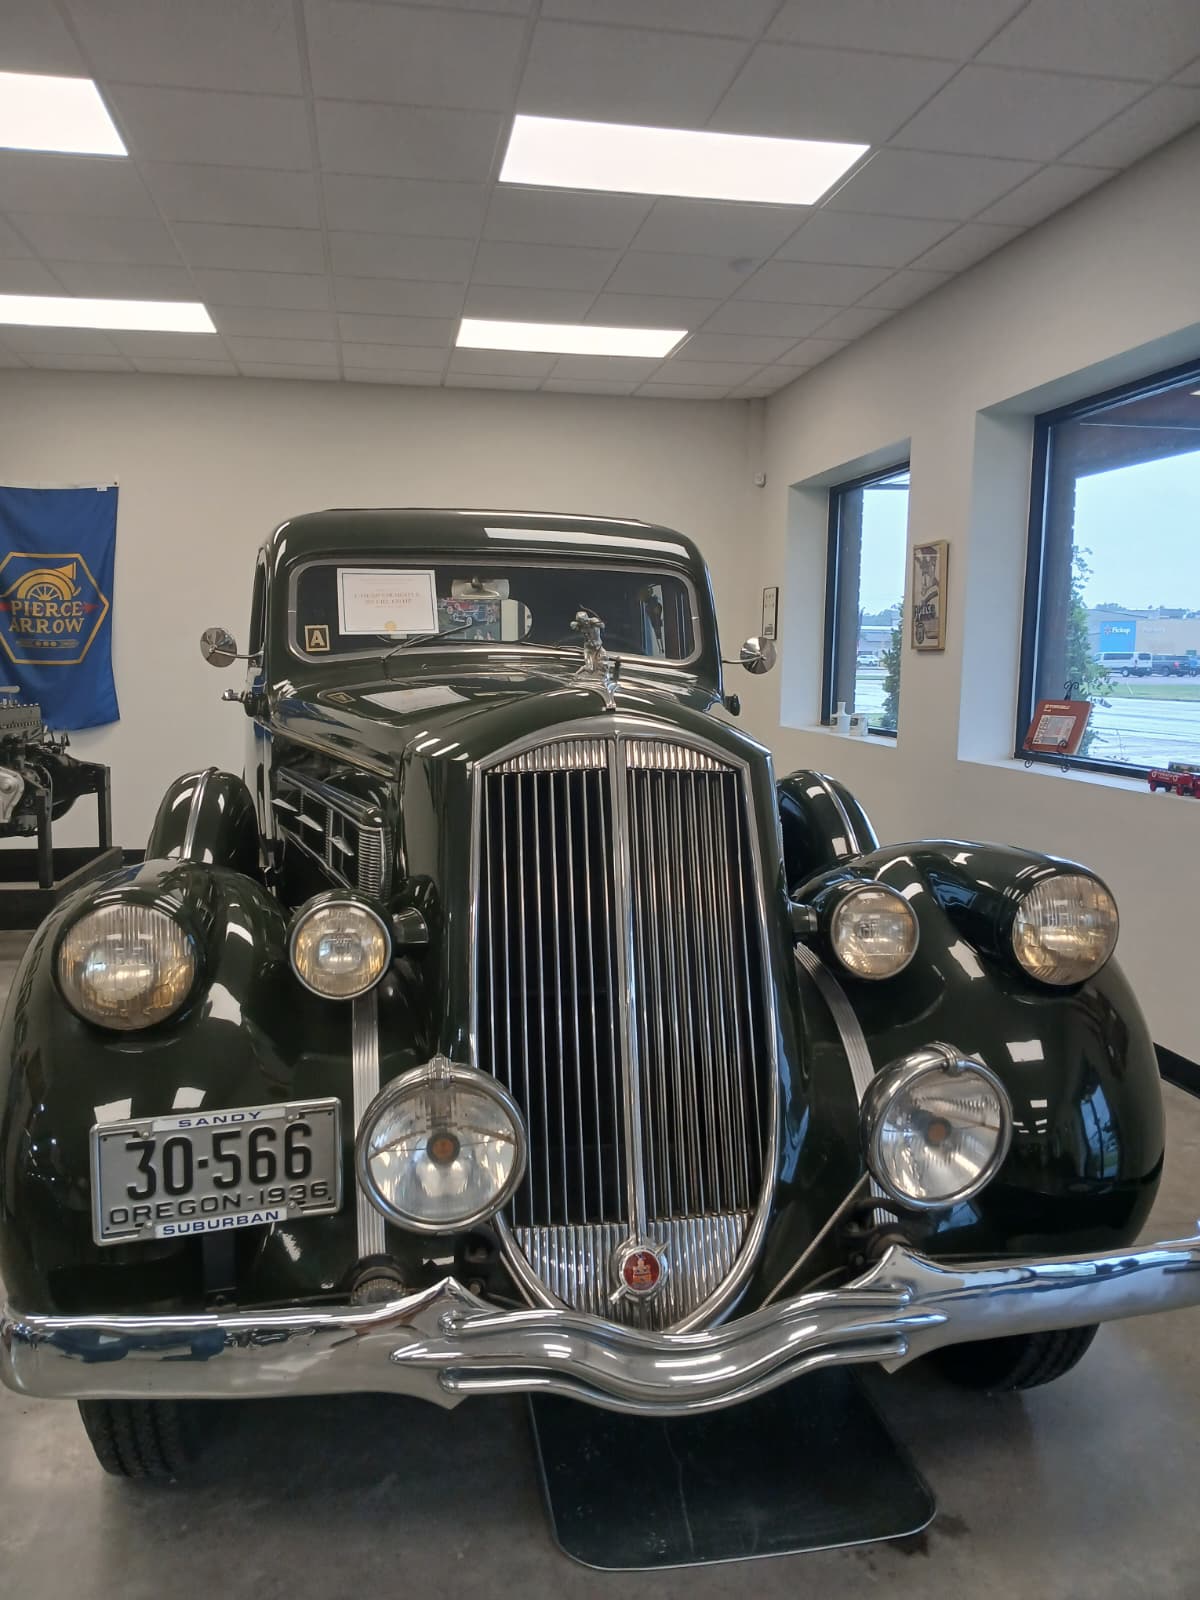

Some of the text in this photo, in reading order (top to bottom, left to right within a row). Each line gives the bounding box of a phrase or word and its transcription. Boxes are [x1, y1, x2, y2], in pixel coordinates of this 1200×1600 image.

[10, 600, 83, 617] PIERCE
[8, 617, 85, 634] ARROW
[310, 629, 326, 647] A
[178, 1111, 262, 1128] SANDY
[125, 1122, 313, 1201] 30-566
[163, 1211, 280, 1235] SUBURBAN
